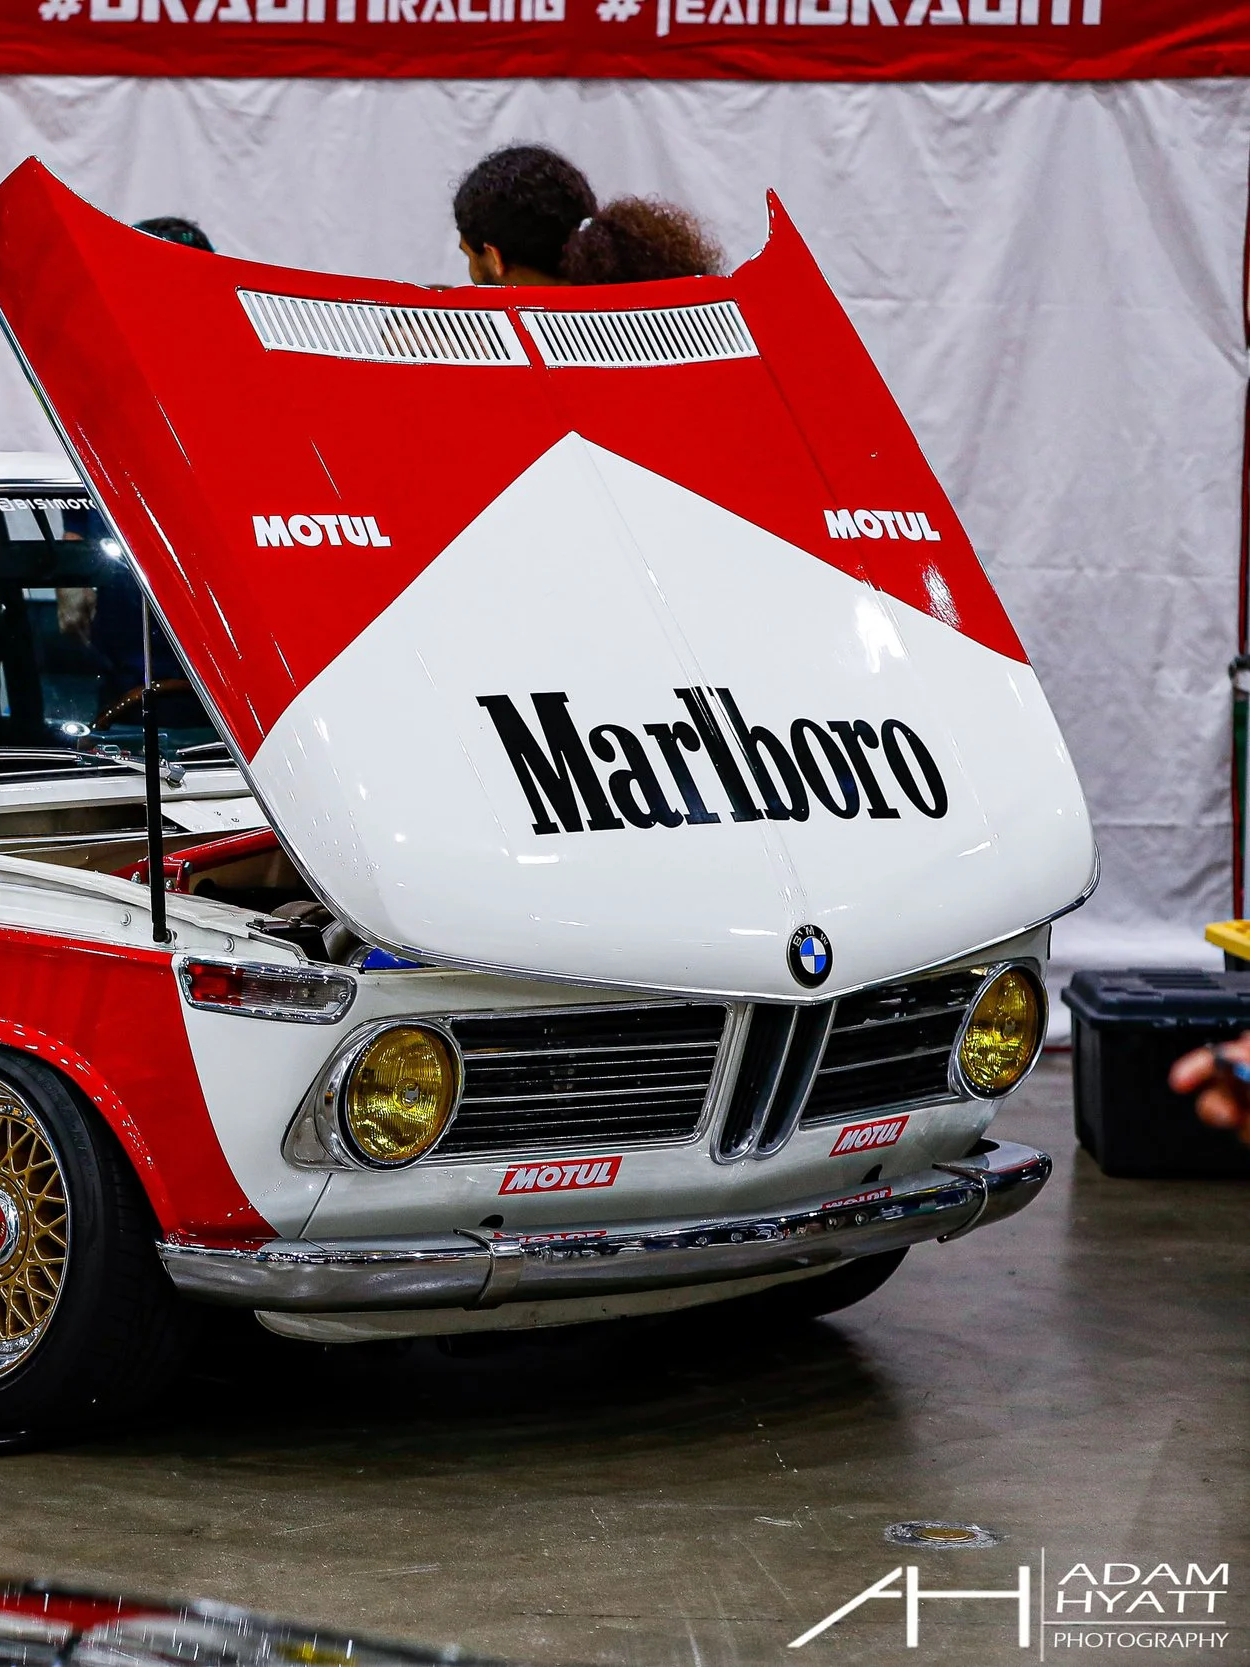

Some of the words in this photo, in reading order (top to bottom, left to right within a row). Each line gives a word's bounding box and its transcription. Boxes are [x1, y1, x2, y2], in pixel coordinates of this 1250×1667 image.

[252, 514, 392, 548] MOTUL
[823, 509, 941, 542] MOTUL
[475, 687, 949, 835] Marlboro
[840, 1120, 902, 1149] MOTUL
[507, 1163, 612, 1190] MOTUL
